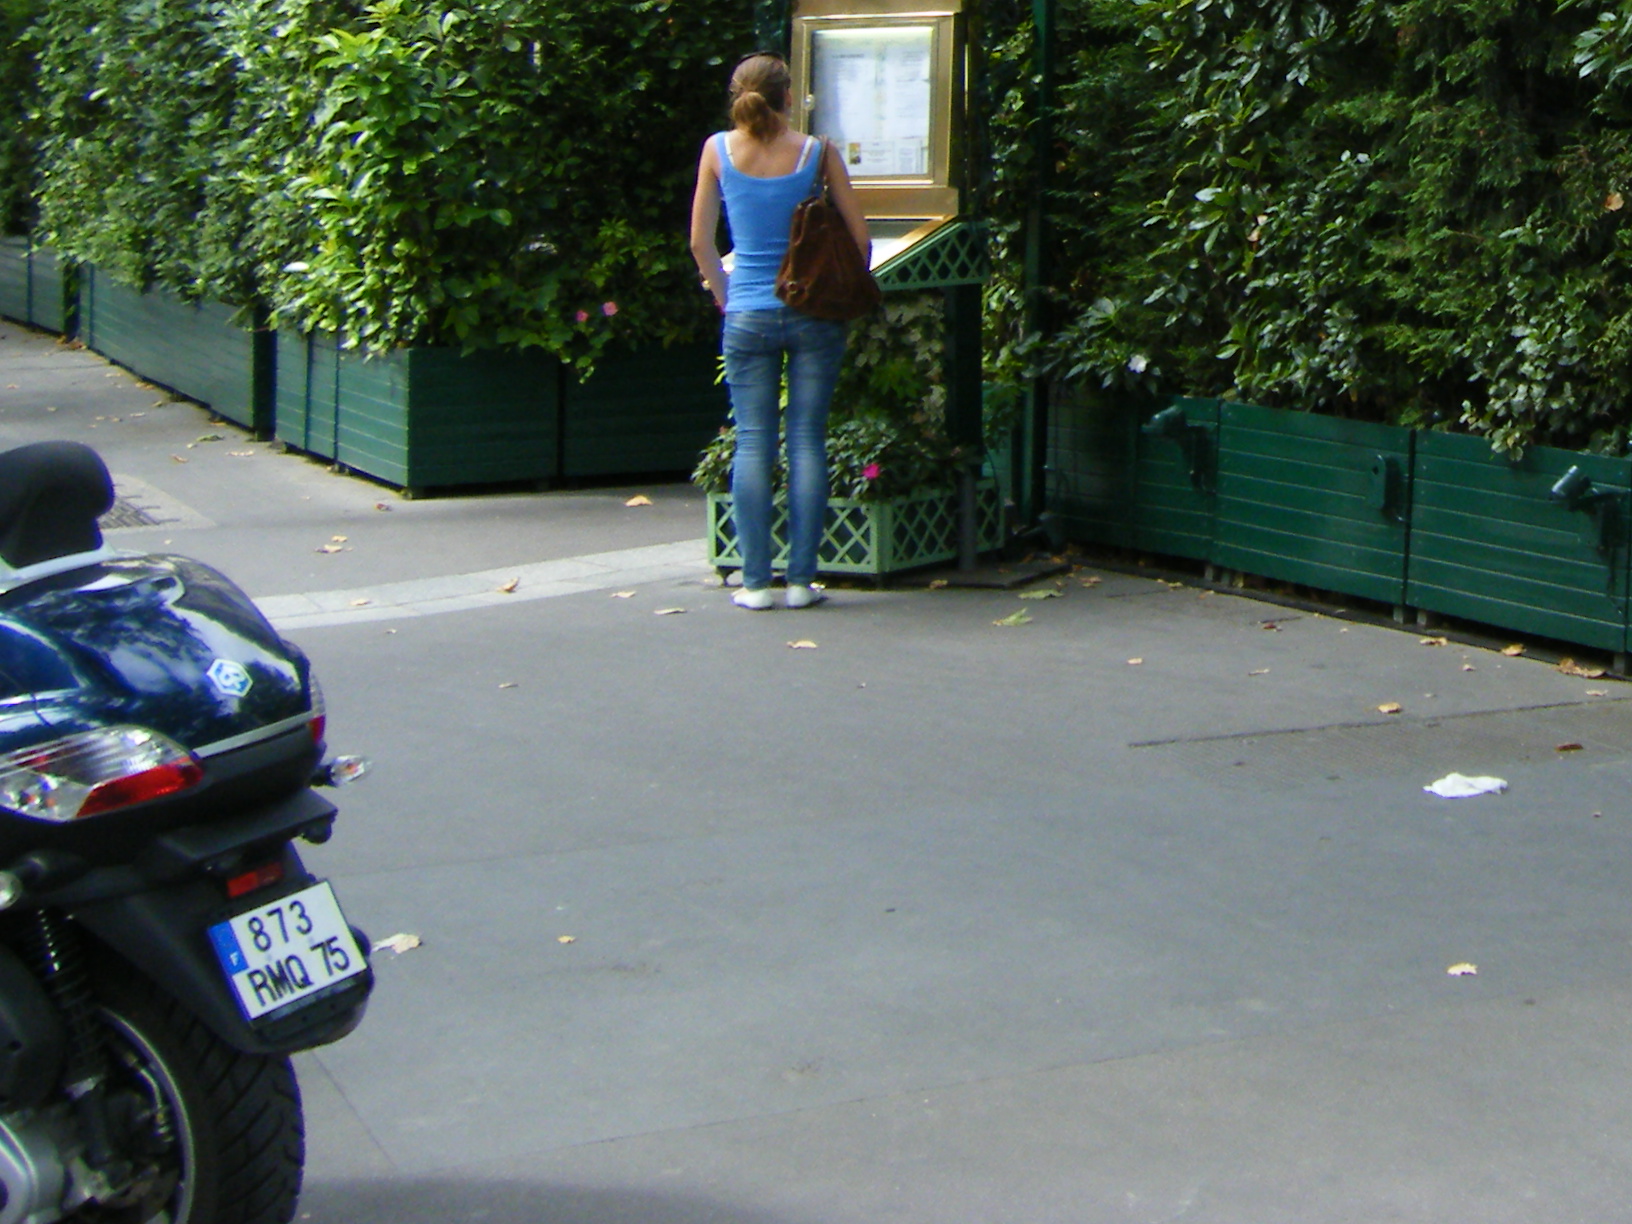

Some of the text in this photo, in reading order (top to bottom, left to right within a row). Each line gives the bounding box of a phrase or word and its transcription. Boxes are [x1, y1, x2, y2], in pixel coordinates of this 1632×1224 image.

[248, 900, 313, 952] 873
[247, 936, 350, 1007] RMQ 75
